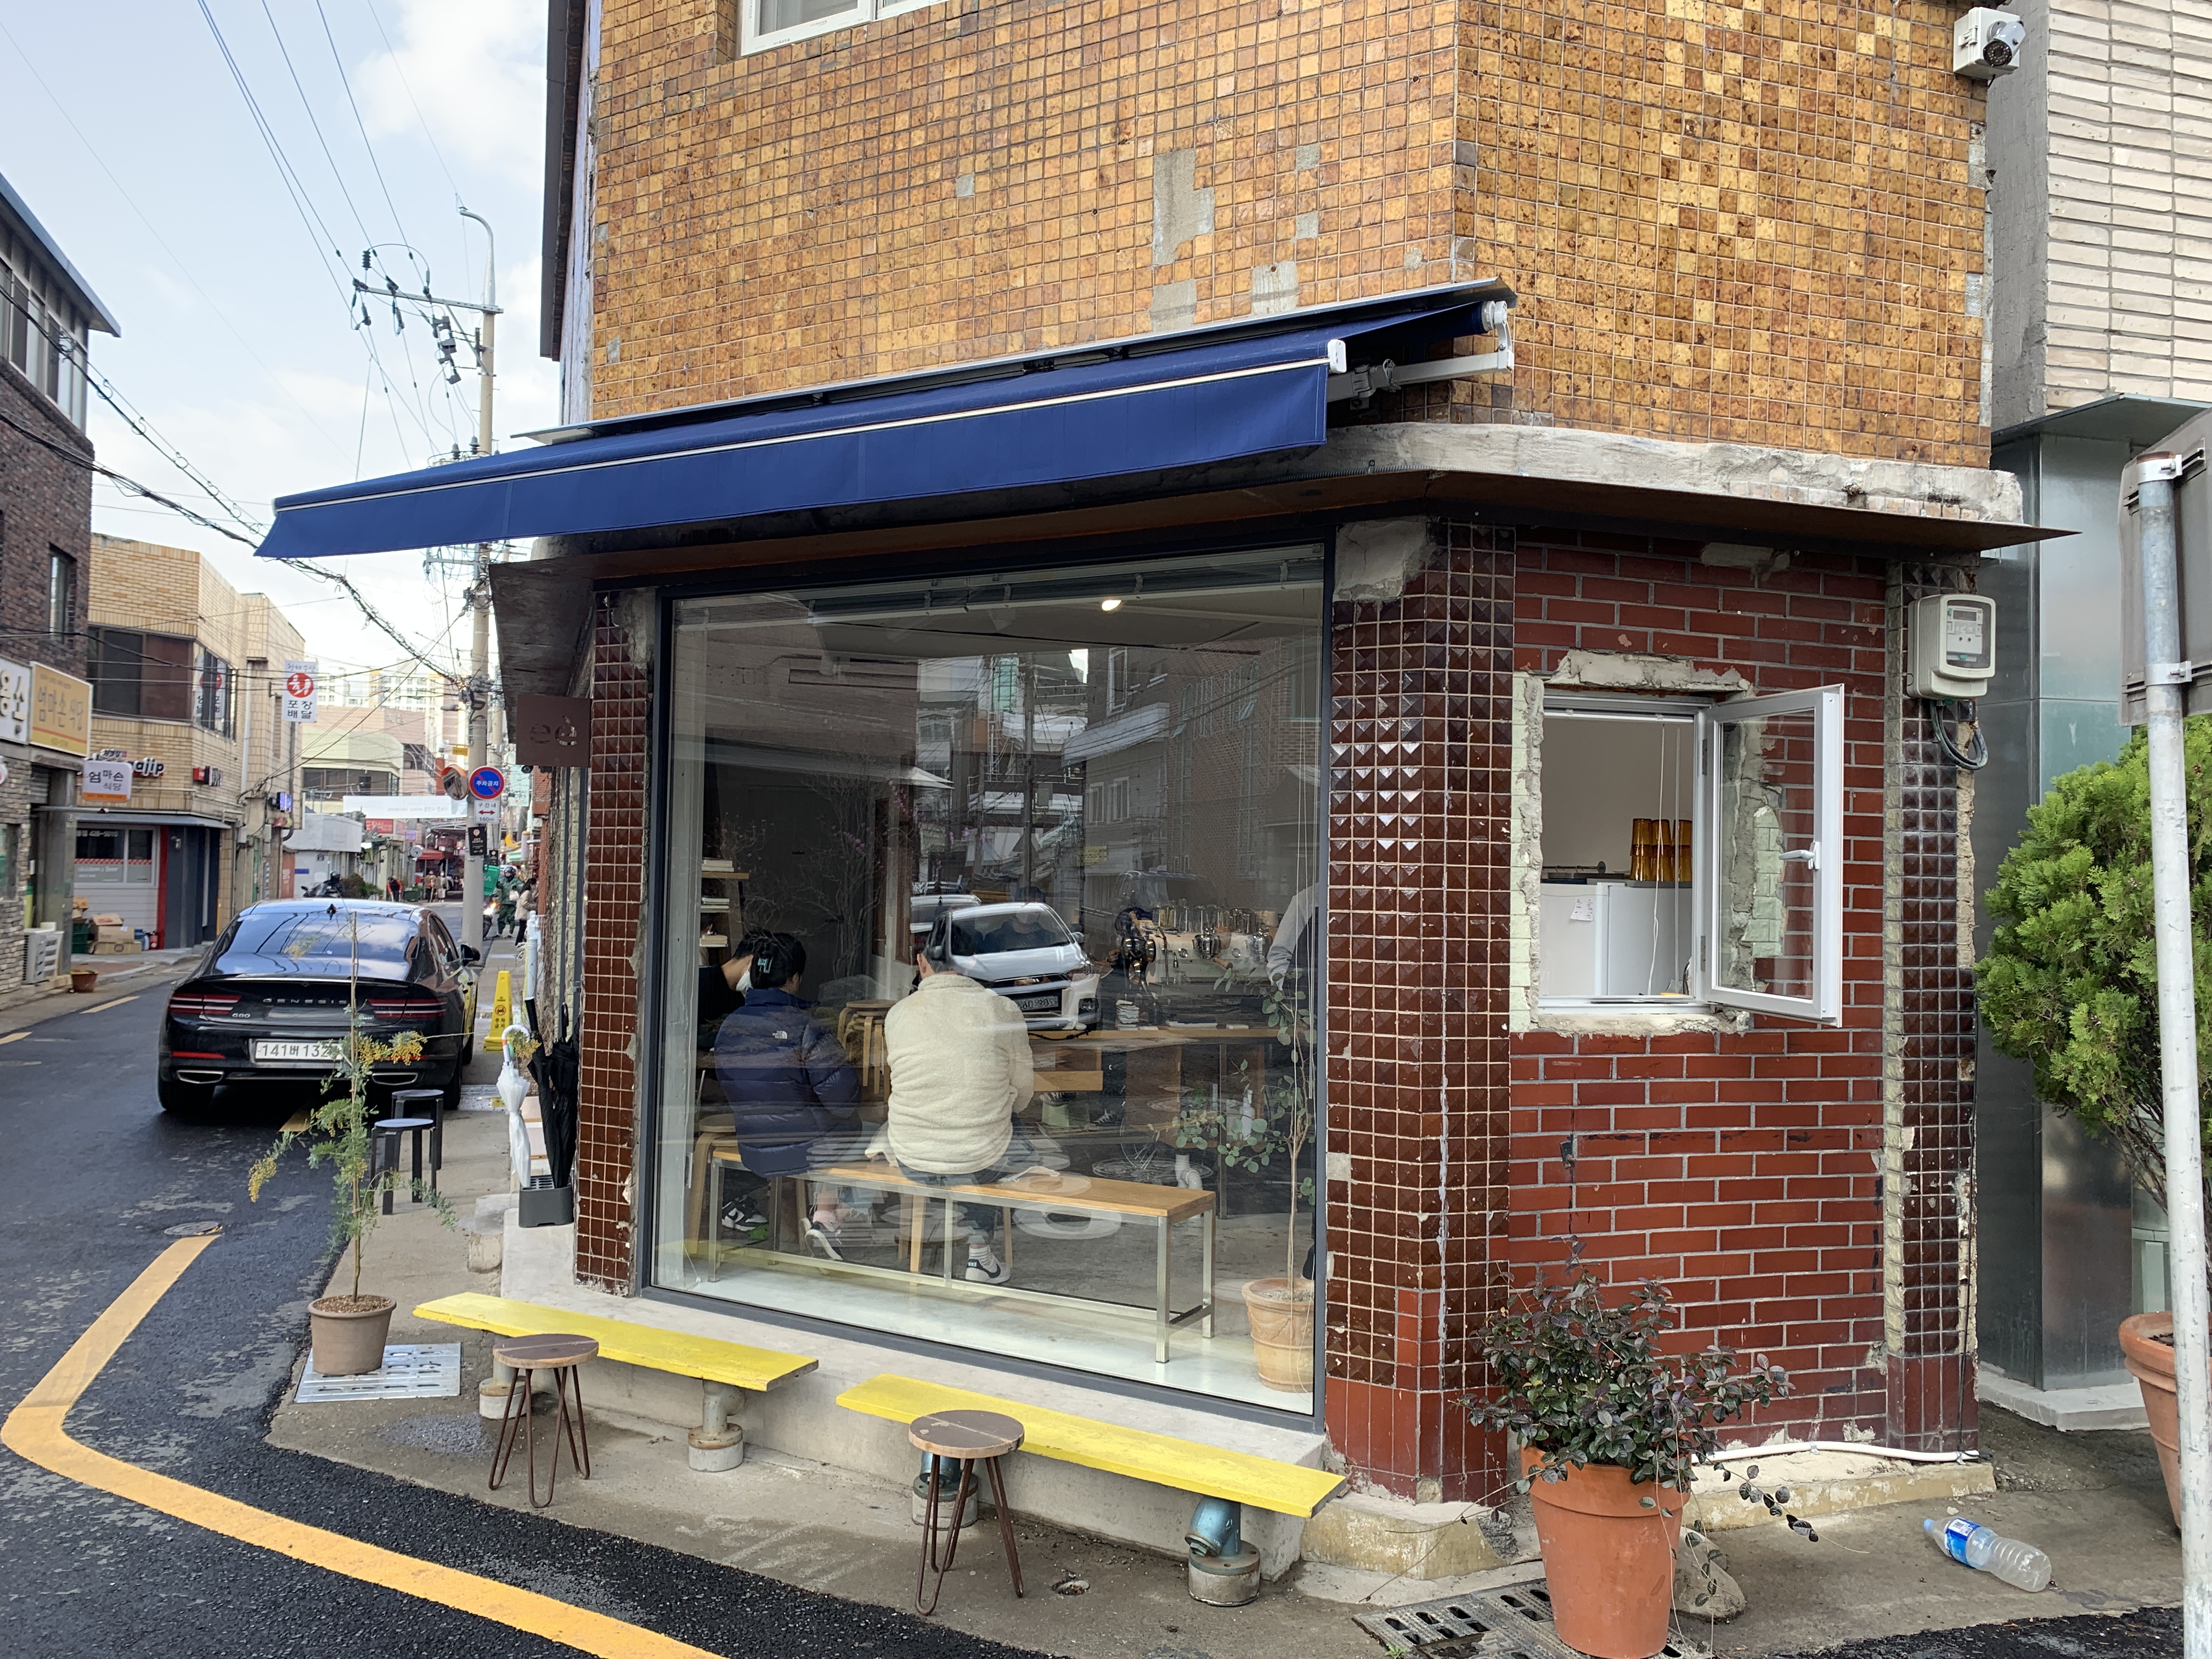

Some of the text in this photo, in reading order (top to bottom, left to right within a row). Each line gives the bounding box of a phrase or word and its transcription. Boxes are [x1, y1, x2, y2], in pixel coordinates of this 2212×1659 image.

[289, 675, 312, 696] 회
[287, 700, 313, 710] 포장
[287, 710, 312, 719] 배달
[88, 770, 123, 783] 엄마손
[103, 783, 122, 791] 식당
